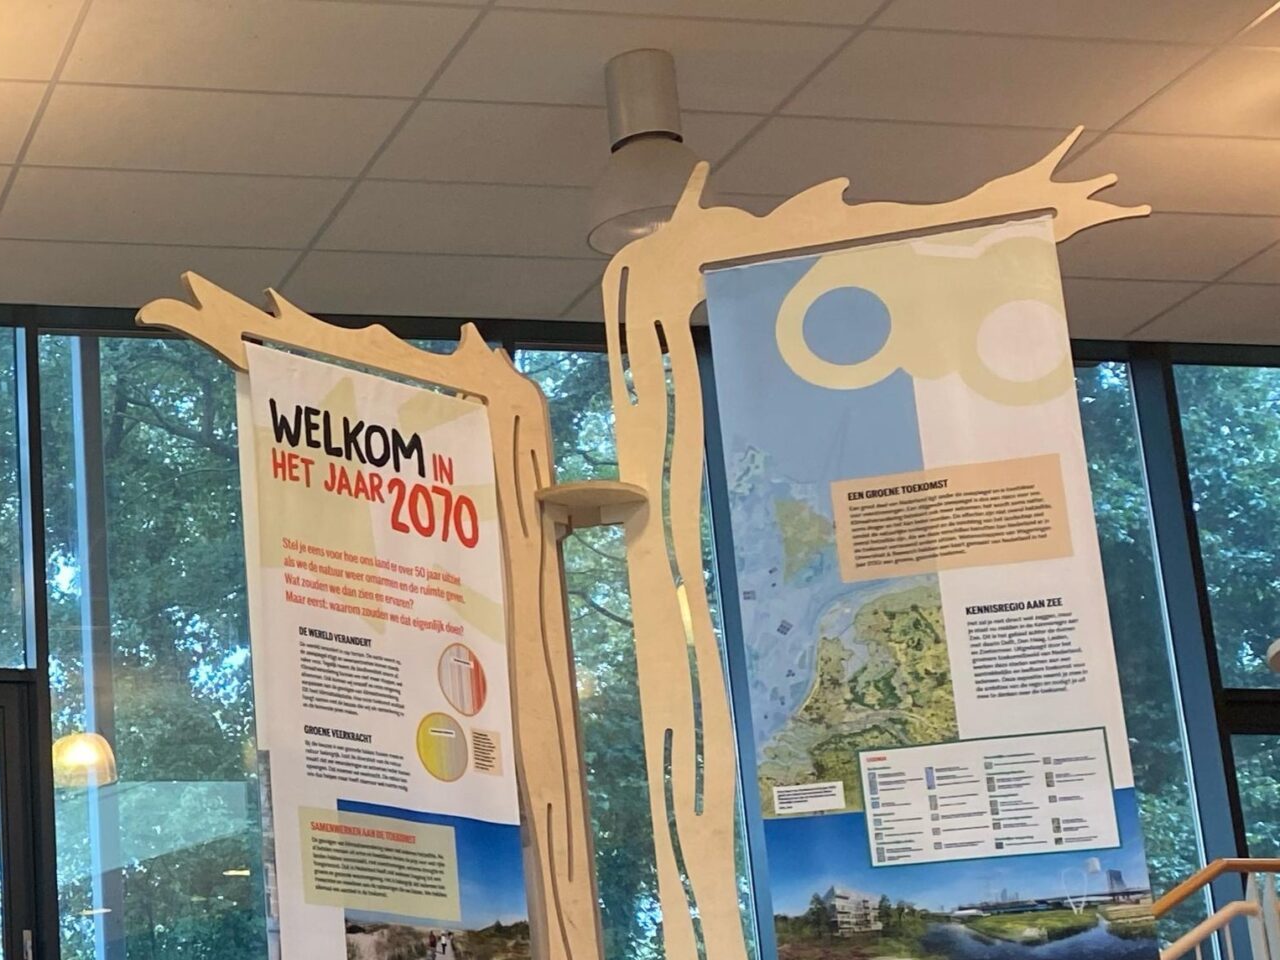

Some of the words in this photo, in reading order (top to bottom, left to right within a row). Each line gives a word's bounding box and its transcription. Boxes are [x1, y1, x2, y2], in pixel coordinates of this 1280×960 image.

[269, 398, 426, 478] WELKOM
[432, 454, 454, 486] IN
[272, 448, 315, 488] HET
[324, 462, 385, 504] JAAR
[388, 478, 479, 549] 2070
[847, 491, 864, 501] EEN
[865, 486, 900, 499] GROENE
[900, 479, 948, 495] TOEKOMST
[282, 537, 299, 551] Stel
[299, 543, 307, 554] je
[308, 546, 325, 558] eens
[326, 549, 343, 560] voor
[344, 551, 358, 564] hoe
[359, 554, 373, 566] ons
[374, 556, 390, 570] land
[398, 564, 414, 575] over
[415, 566, 426, 577] 50
[426, 568, 441, 582] jaar
[284, 556, 295, 568] als
[296, 560, 307, 570] we
[309, 561, 318, 573] de
[319, 565, 344, 577] natuur
[345, 570, 364, 582] weer
[365, 573, 399, 588] omarmen
[399, 580, 408, 591] en
[409, 581, 419, 593] de
[420, 585, 445, 599] ruimte
[284, 573, 300, 586] Wat
[301, 577, 328, 593] zouden
[329, 583, 341, 595] we
[342, 585, 357, 598] dan
[358, 587, 374, 600] zien
[375, 592, 384, 602] en
[385, 594, 414, 609] ervaren?
[965, 602, 1025, 615] KENNISREGIO
[1026, 600, 1045, 611] AAN
[1046, 598, 1063, 608] ZEE
[286, 591, 305, 604] Maar
[307, 596, 328, 609] eerst:
[329, 601, 360, 614] waarom
[362, 605, 389, 619] zouden
[389, 611, 399, 622] we
[400, 613, 411, 626] dat
[445, 622, 464, 635] doen?
[298, 626, 307, 637] DE
[307, 628, 333, 642] WERELD
[334, 633, 372, 647] VERANDERT
[304, 725, 330, 738] GROENE
[331, 729, 372, 744] VEERKRACHT
